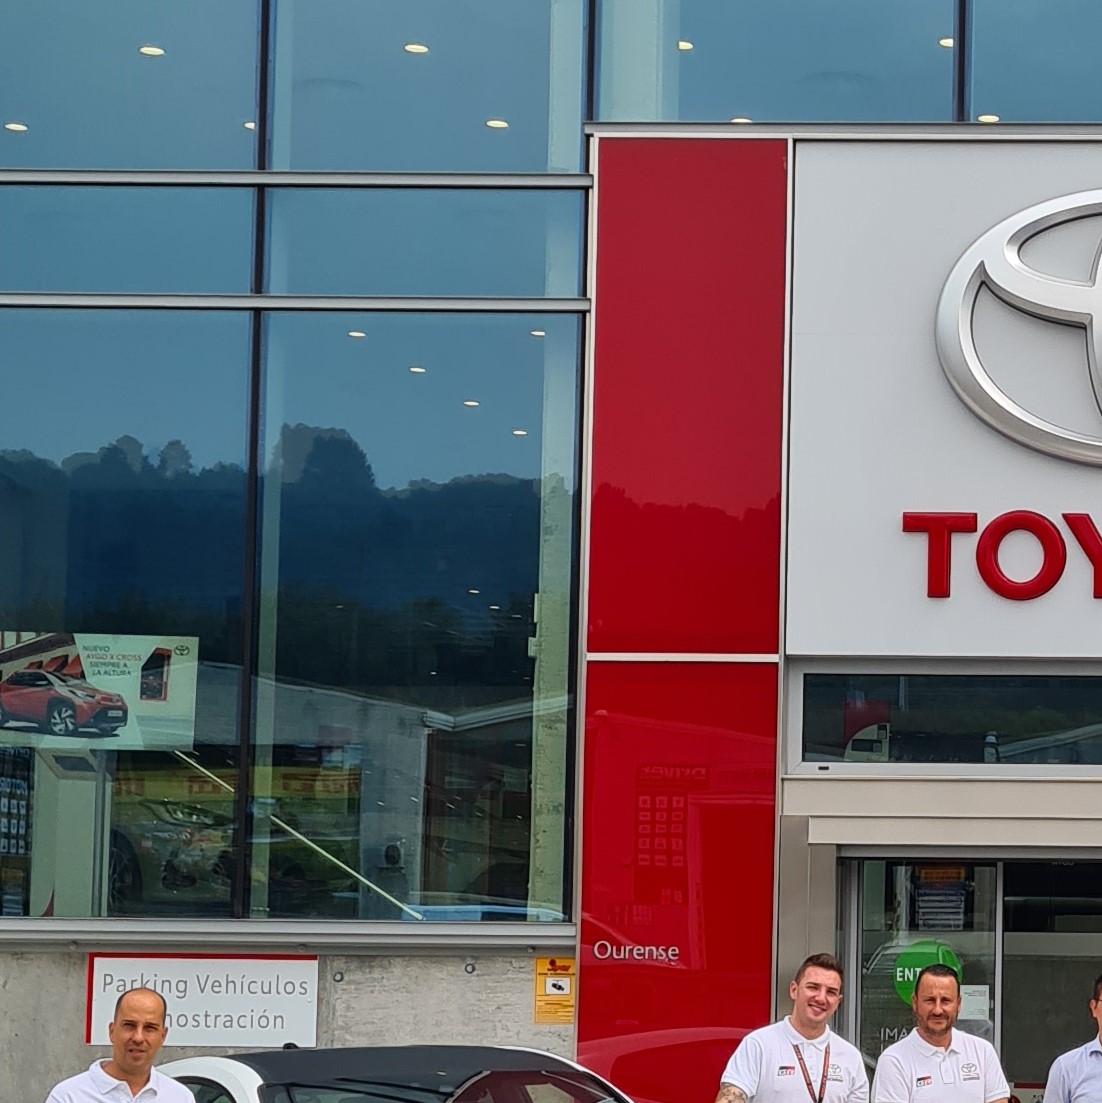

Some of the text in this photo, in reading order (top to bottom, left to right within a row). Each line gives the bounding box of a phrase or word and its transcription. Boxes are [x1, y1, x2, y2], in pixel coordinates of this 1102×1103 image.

[82, 645, 110, 653] NUEVO
[593, 940, 680, 960] Ourense
[896, 967, 922, 982] ENT
[102, 972, 309, 999] Parking Vehículos
[165, 1008, 286, 1030] ostración
[880, 1027, 908, 1041] IMA
